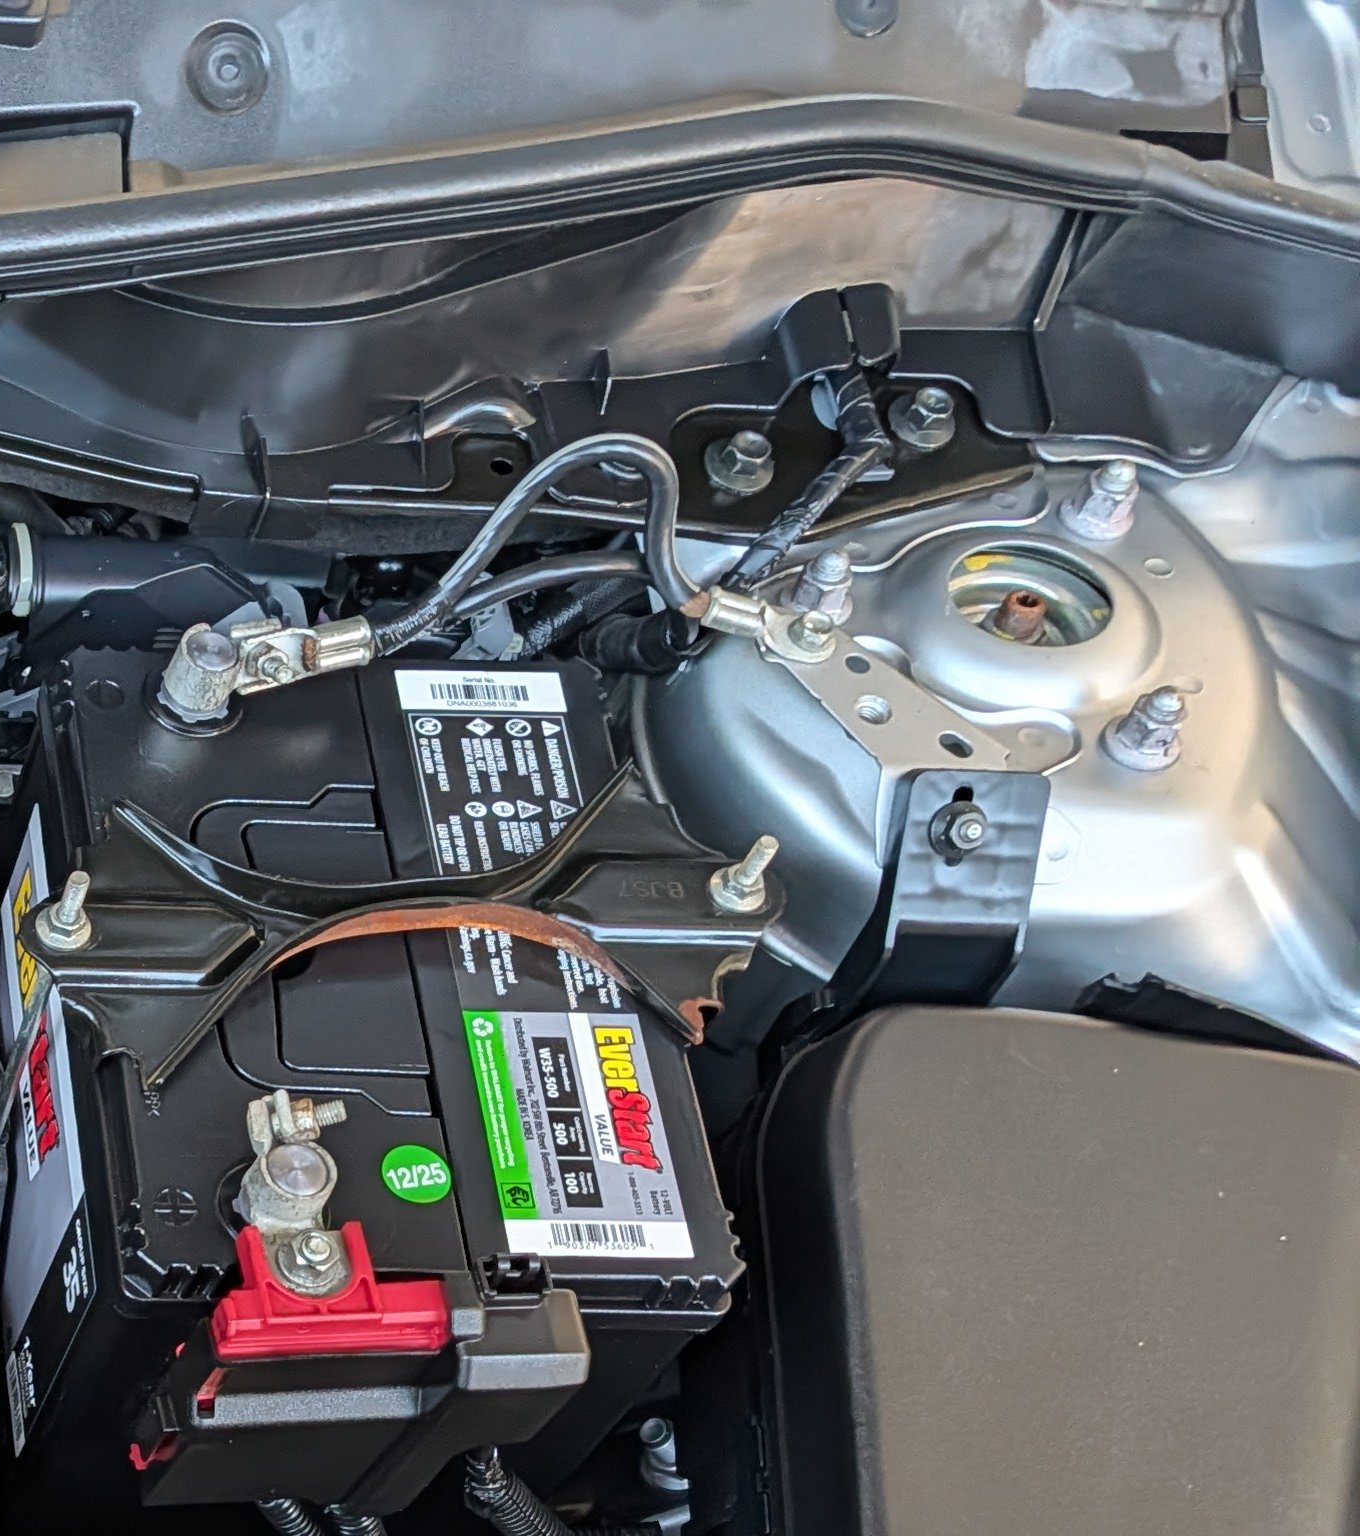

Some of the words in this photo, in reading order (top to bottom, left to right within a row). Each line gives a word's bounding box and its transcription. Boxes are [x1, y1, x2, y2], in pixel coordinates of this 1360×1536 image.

[544, 738, 569, 798] DANGER/POISON
[439, 839, 454, 864] BATTERY
[538, 1047, 558, 1097] W35-500
[592, 1026, 662, 1170] EverStart
[537, 1132, 547, 1149] Street
[552, 1122, 567, 1144] 500
[594, 1114, 613, 1155] VALUE
[386, 1162, 447, 1190] 12/25
[563, 1172, 578, 1193] 100
[649, 1190, 660, 1215] Battery
[660, 1190, 672, 1215] 12-VOLT
[62, 1246, 80, 1313] 35
[22, 1335, 36, 1407] 1-Year
